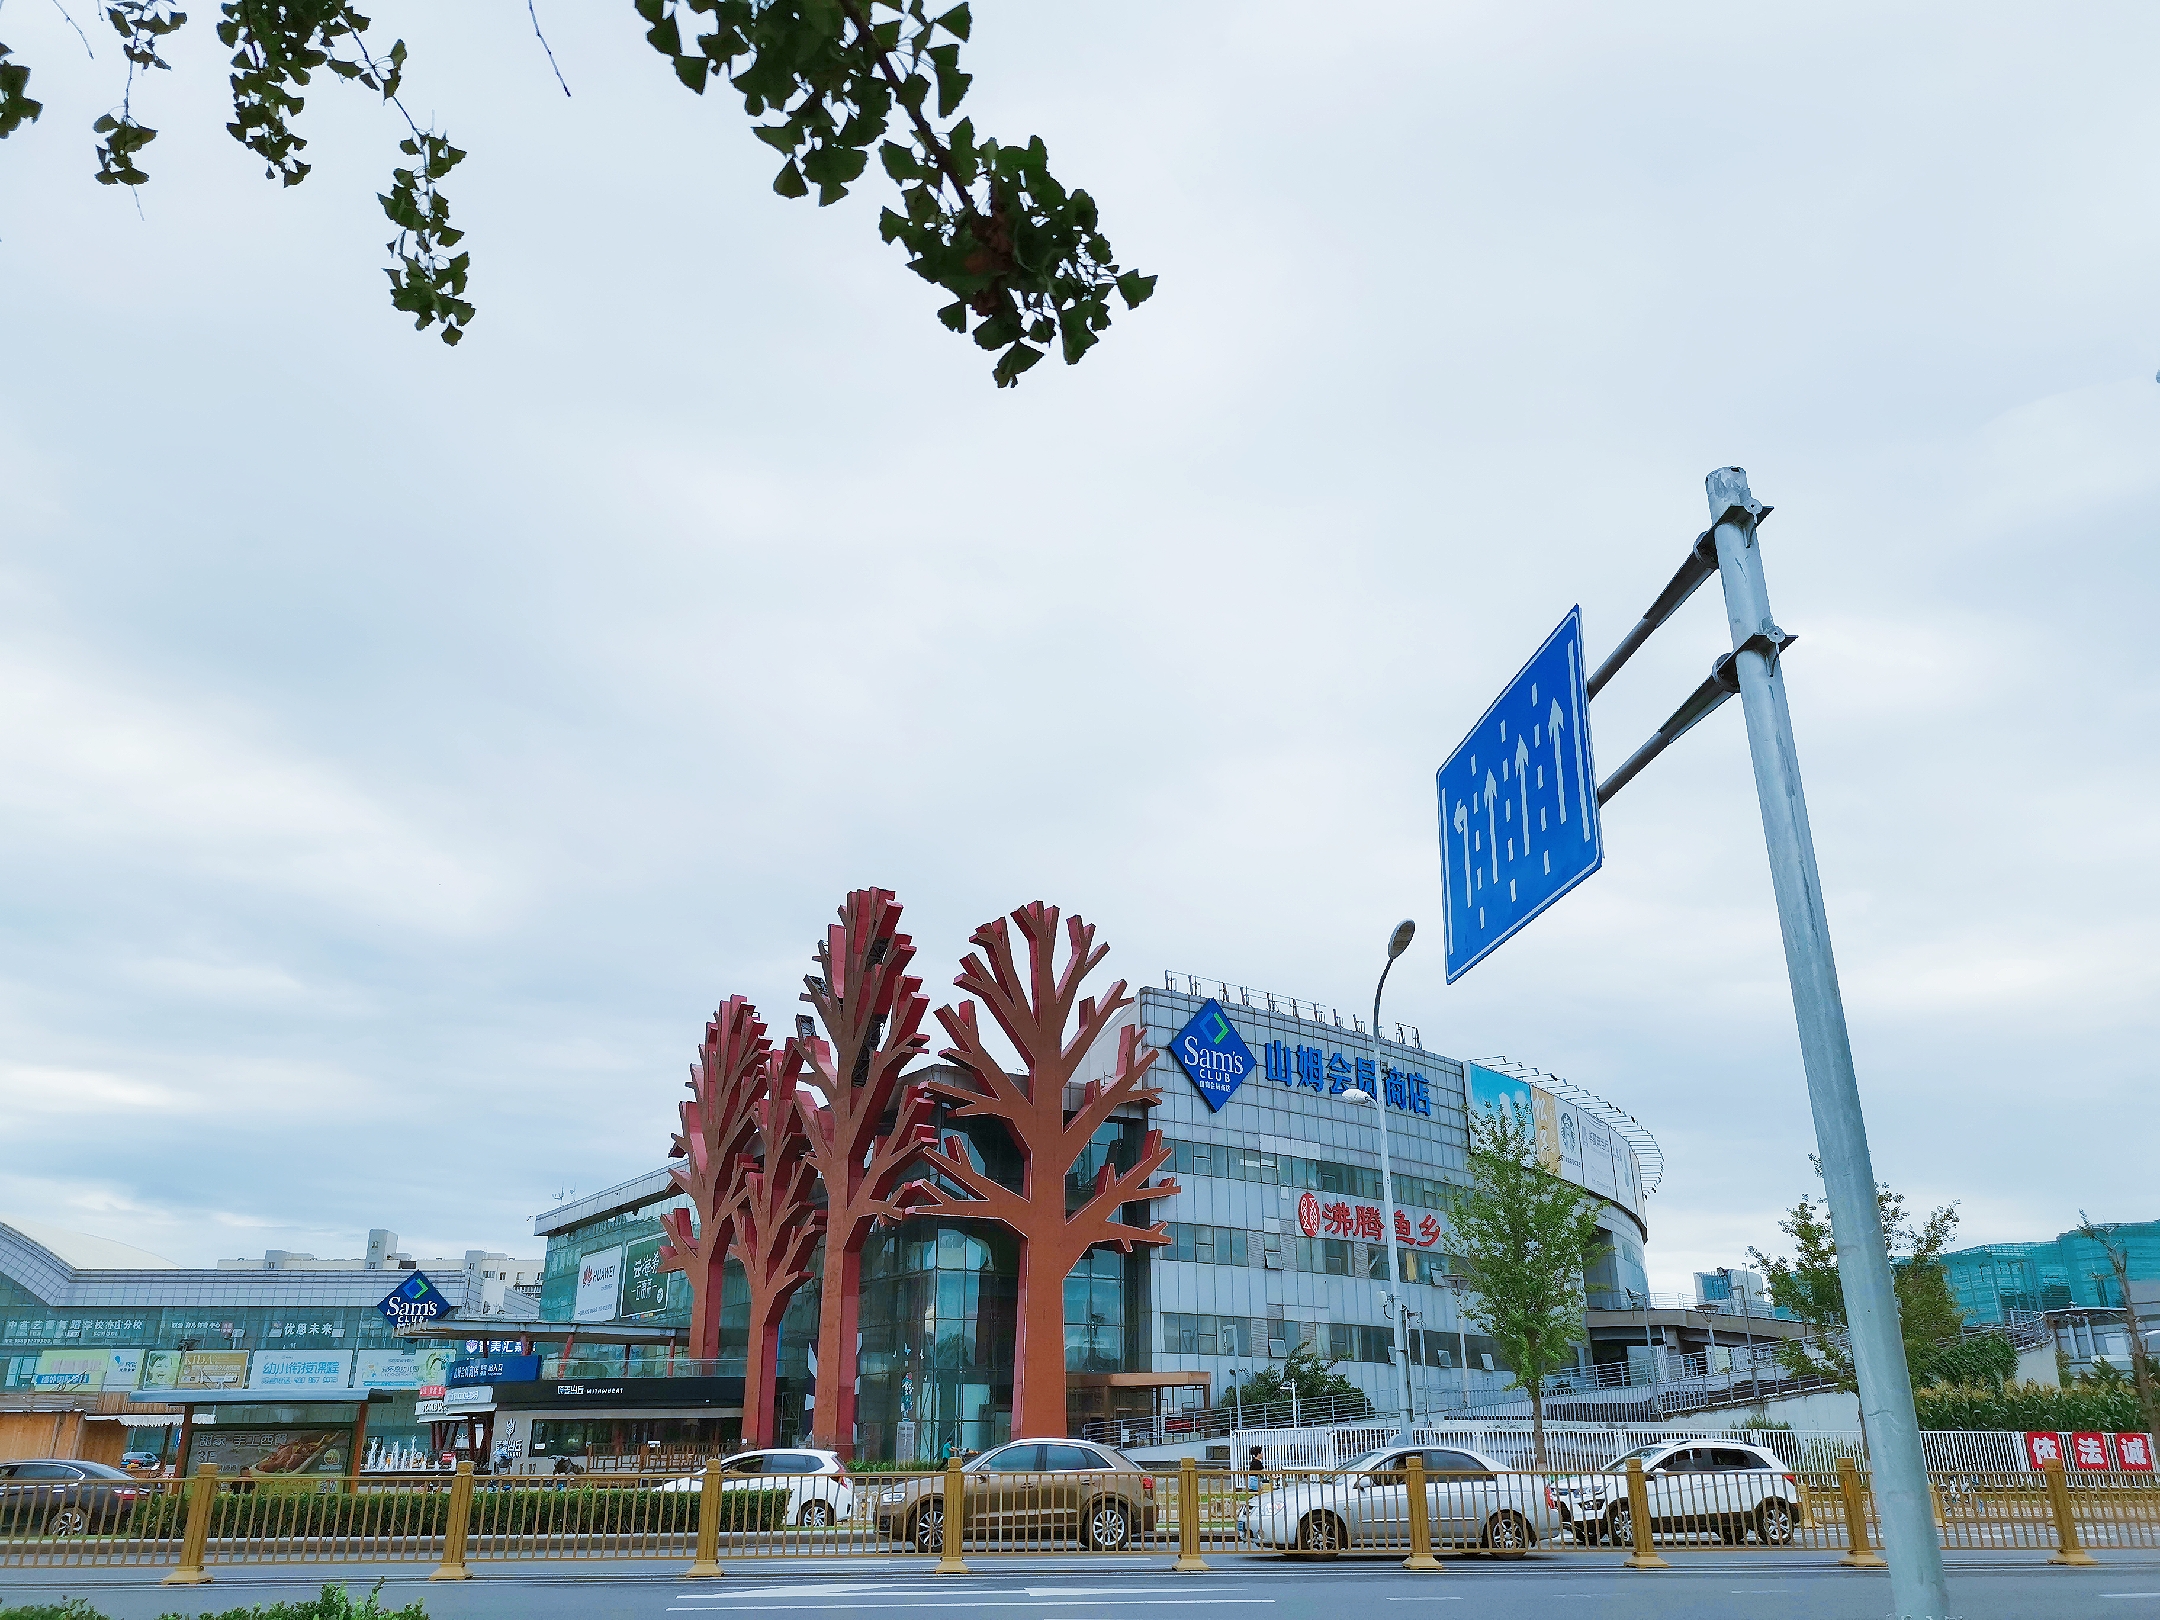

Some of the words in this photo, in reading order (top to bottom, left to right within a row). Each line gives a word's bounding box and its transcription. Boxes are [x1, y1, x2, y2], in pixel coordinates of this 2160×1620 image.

[1184, 1035, 1244, 1075] Sam's
[1199, 1068, 1231, 1083] CLUB
[1265, 1040, 1432, 1116] 山姆会员商店
[1322, 1202, 1441, 1247] 沸腾鱼乡
[593, 1265, 617, 1283] HUAWEI
[386, 1296, 438, 1316] Sam's
